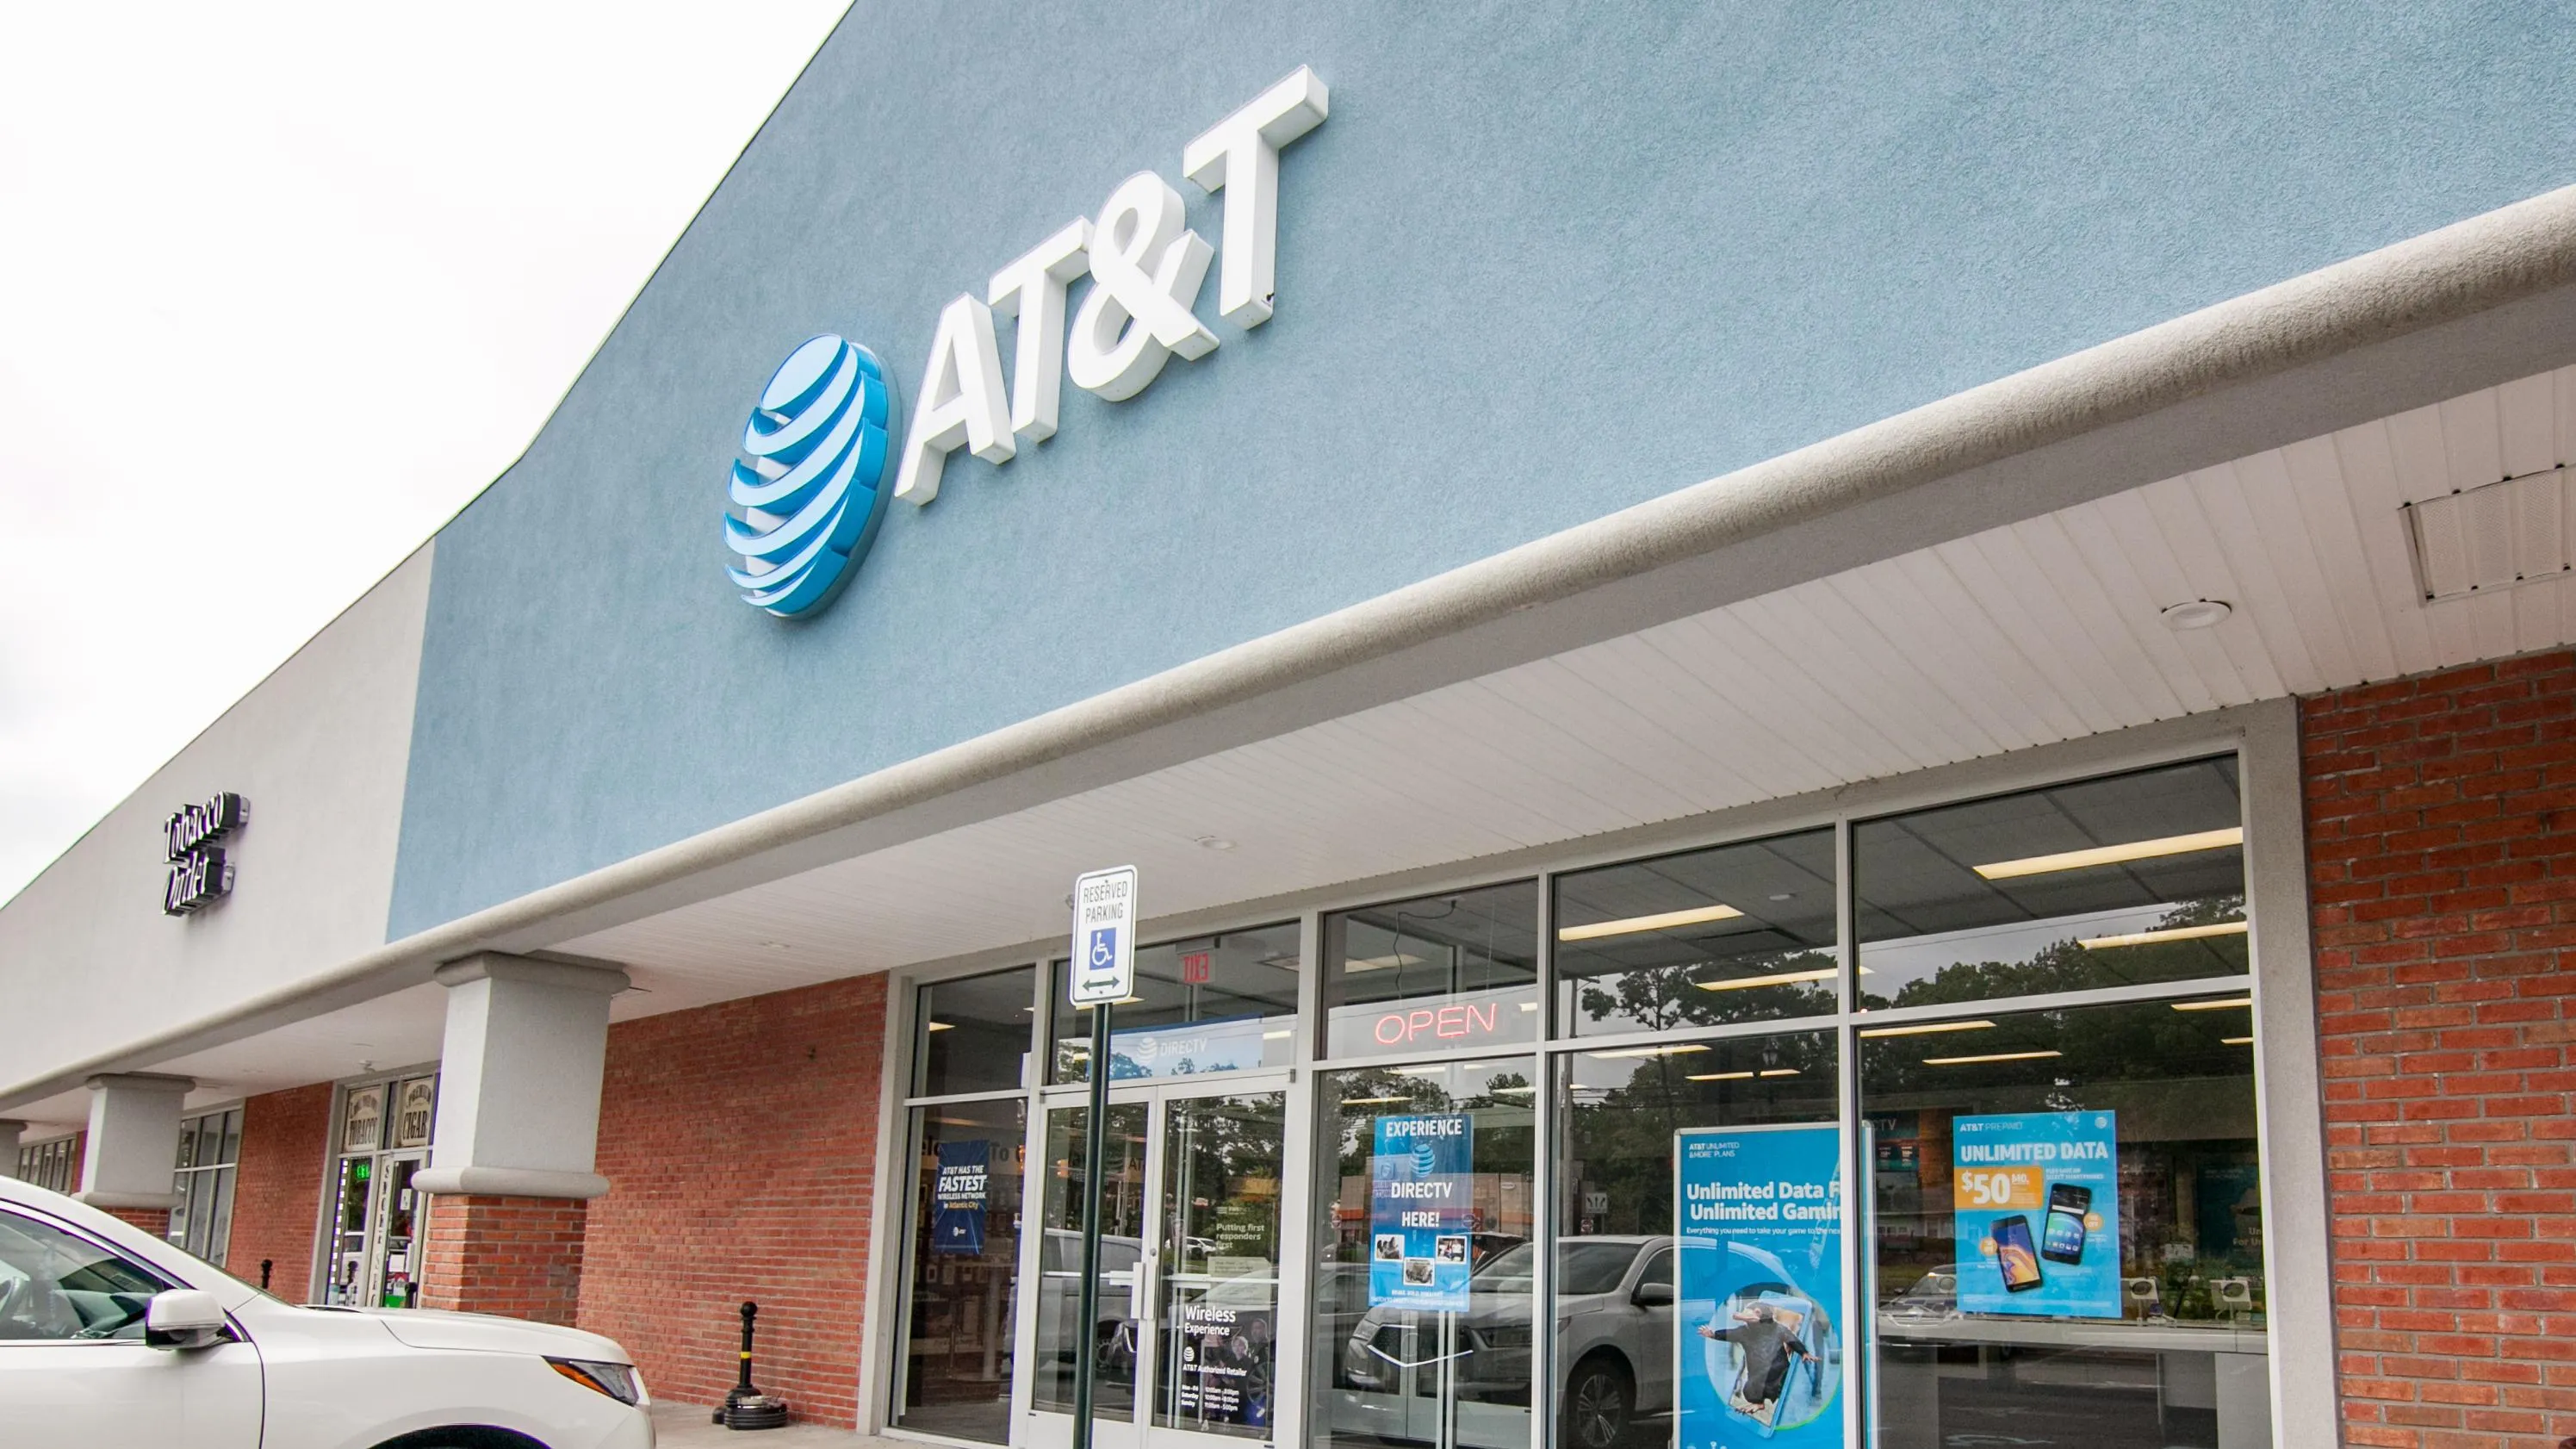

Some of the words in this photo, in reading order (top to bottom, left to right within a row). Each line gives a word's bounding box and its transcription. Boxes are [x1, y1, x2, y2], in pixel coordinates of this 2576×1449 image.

[894, 64, 1328, 507] AT&T
[164, 791, 233, 864] Tobacco
[162, 850, 217, 916] Outlet
[1083, 880, 1127, 904] RESERVED
[1085, 902, 1123, 924] PARKING
[1375, 1003, 1497, 1045] OPEN
[1160, 1037, 1207, 1057] DIRECTV
[1385, 1119, 1462, 1137] EXPERIENCE
[1959, 1123, 1983, 1132] AT&T
[1984, 1122, 2023, 1131] PREPAID
[1960, 1143, 2056, 1162] UNLIMITED
[2060, 1141, 2108, 1160] DATA
[942, 1166, 958, 1175] AT&T
[958, 1166, 971, 1174] HAS
[972, 1165, 984, 1174] THE
[939, 1175, 987, 1192] FASTEST
[1391, 1182, 1453, 1198] DIRECTV
[1686, 1182, 1774, 1200] Unlimited
[1778, 1181, 1824, 1199] Data
[1961, 1170, 2011, 1204] $50
[969, 1201, 978, 1210] City
[1691, 1202, 1778, 1221] Unlimited
[1783, 1202, 1841, 1221] Gamin
[1216, 1223, 1246, 1232] Putting
[1247, 1223, 1264, 1232] first
[1401, 1211, 1440, 1227] HERE!
[1686, 1227, 1719, 1235] Everything
[1216, 1241, 1233, 1249] first
[1184, 1305, 1237, 1323] Wireless
[1184, 1322, 1231, 1336] Experience
[1182, 1364, 1197, 1372] AT&T
[1198, 1365, 1226, 1375] Authorized
[1226, 1367, 1247, 1377] Retailer
